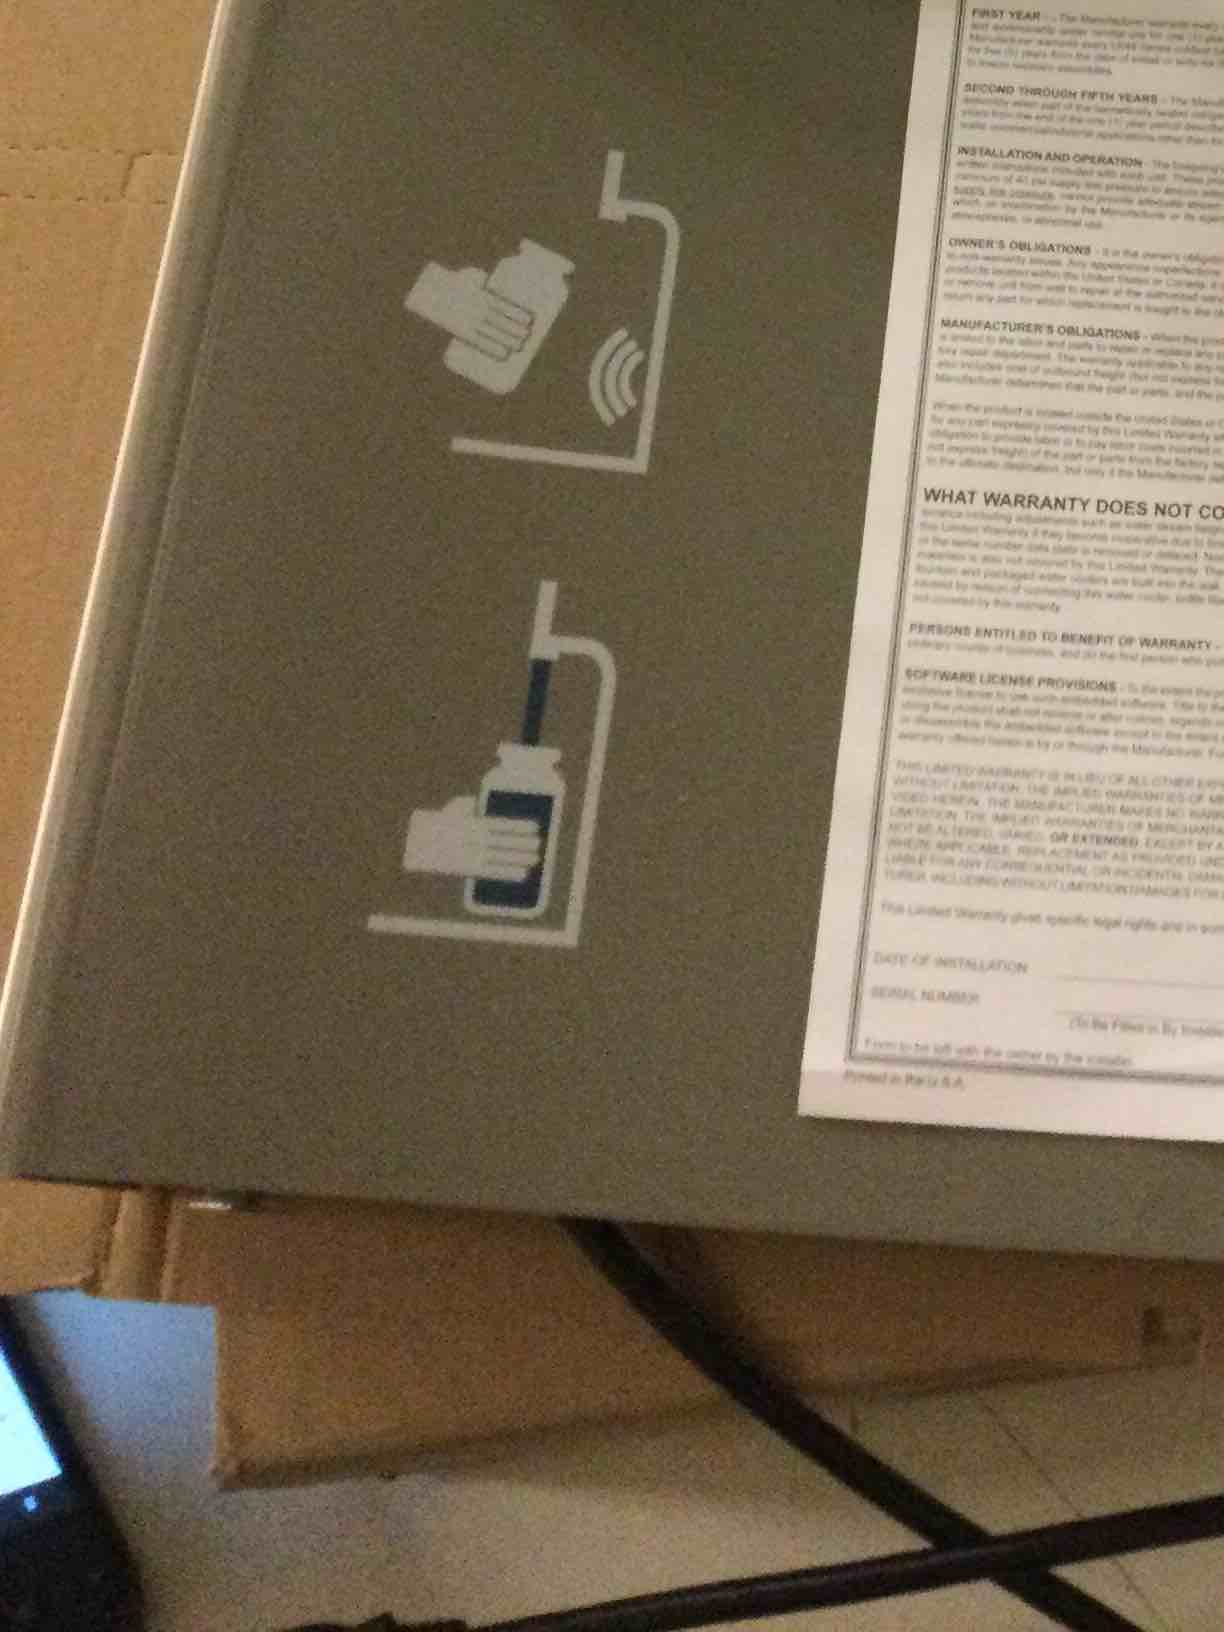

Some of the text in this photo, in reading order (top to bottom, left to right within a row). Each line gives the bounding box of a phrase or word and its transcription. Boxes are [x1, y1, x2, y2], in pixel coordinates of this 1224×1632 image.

[1009, 10, 1042, 22] YEAR
[963, 82, 1015, 96] SECOND
[1019, 85, 1078, 100] THROUGH
[1081, 89, 1115, 103] FIFTH
[1118, 91, 1159, 105] YEARS
[957, 145, 1144, 168] INSTALLATION AND OPERATION
[948, 237, 1092, 256] OWNER'S OBLIGATIONS
[941, 318, 1054, 335] MANUFACTURER'S
[1056, 325, 1141, 342] OBLIGATIONS
[923, 487, 978, 505] WHAT
[982, 491, 1092, 514] WARRANTY
[1096, 498, 1148, 517] DOES
[1154, 502, 1193, 519] NOT
[909, 622, 972, 638] PERSONS
[974, 627, 1038, 642] ENTITLED
[1042, 630, 1059, 643] TO
[1060, 632, 1115, 647] BENEFIT
[1118, 635, 1136, 649] OF
[1138, 636, 1213, 651] WARRANTY
[905, 667, 1117, 693] SOFTWARE LICENSE PROVISIONS
